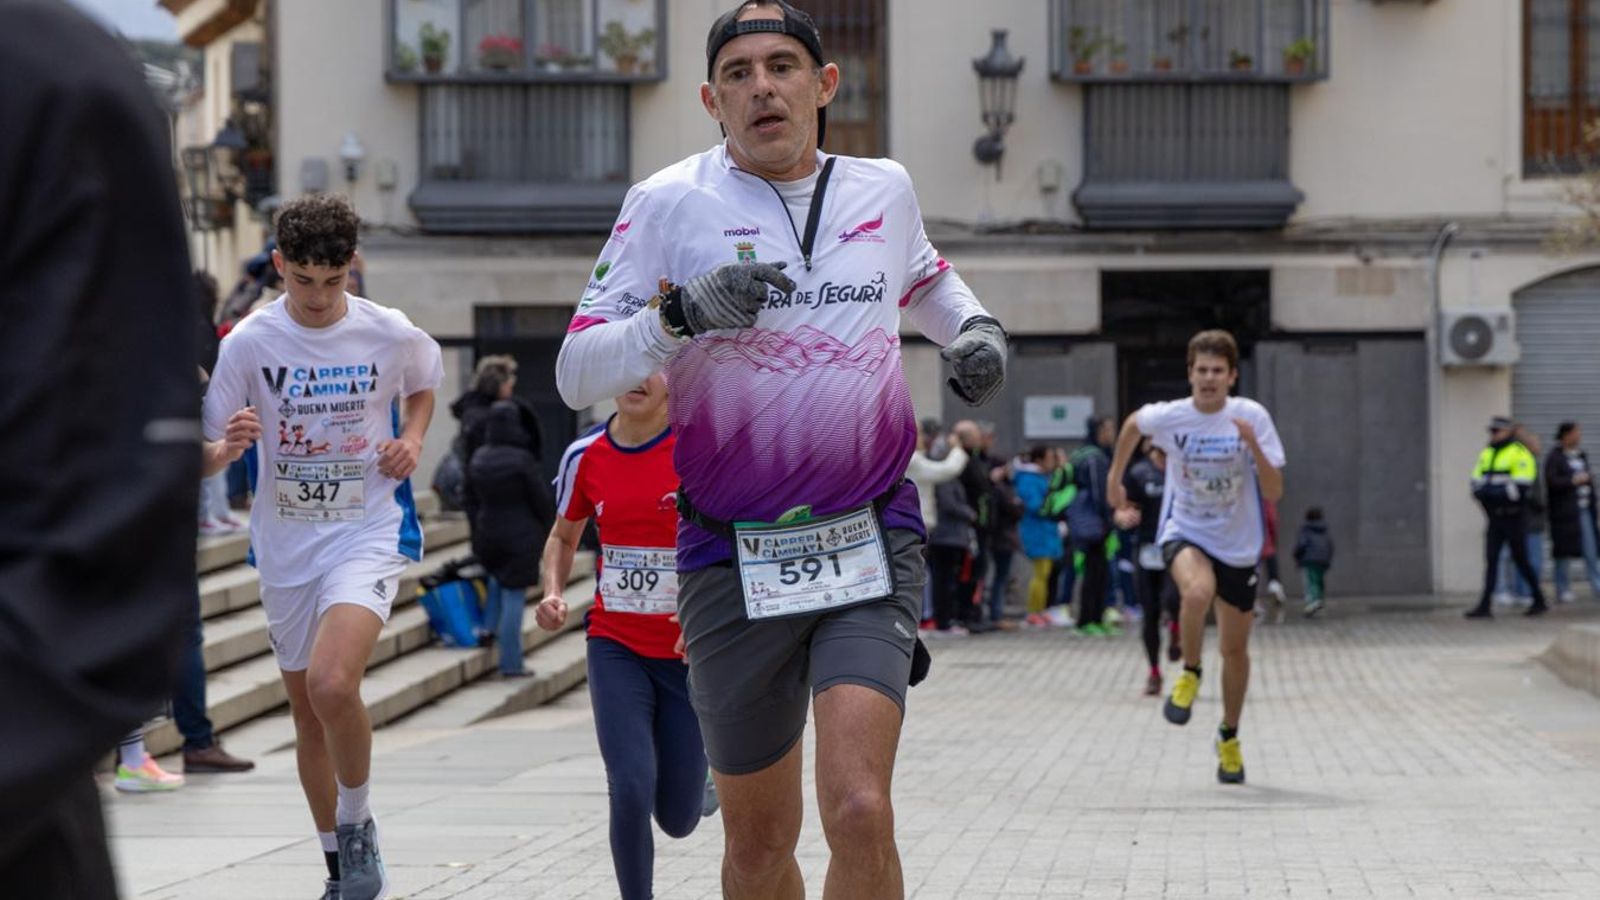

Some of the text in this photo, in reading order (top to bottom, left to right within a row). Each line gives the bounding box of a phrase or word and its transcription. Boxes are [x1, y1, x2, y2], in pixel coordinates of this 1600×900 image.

[795, 291, 813, 305] DE
[811, 282, 883, 310] SEGURA
[261, 362, 379, 398] V CARRERA
[289, 378, 376, 398] CAMINATA
[297, 399, 366, 415] BUENA MUERTE
[277, 463, 288, 475] V
[297, 481, 341, 502] 347
[842, 519, 869, 535] BUENA
[844, 530, 871, 544] MUERTE
[742, 531, 822, 557] V CARRERA
[762, 542, 825, 559] CAMINATA
[779, 554, 842, 586] 591
[616, 570, 659, 592] 309
